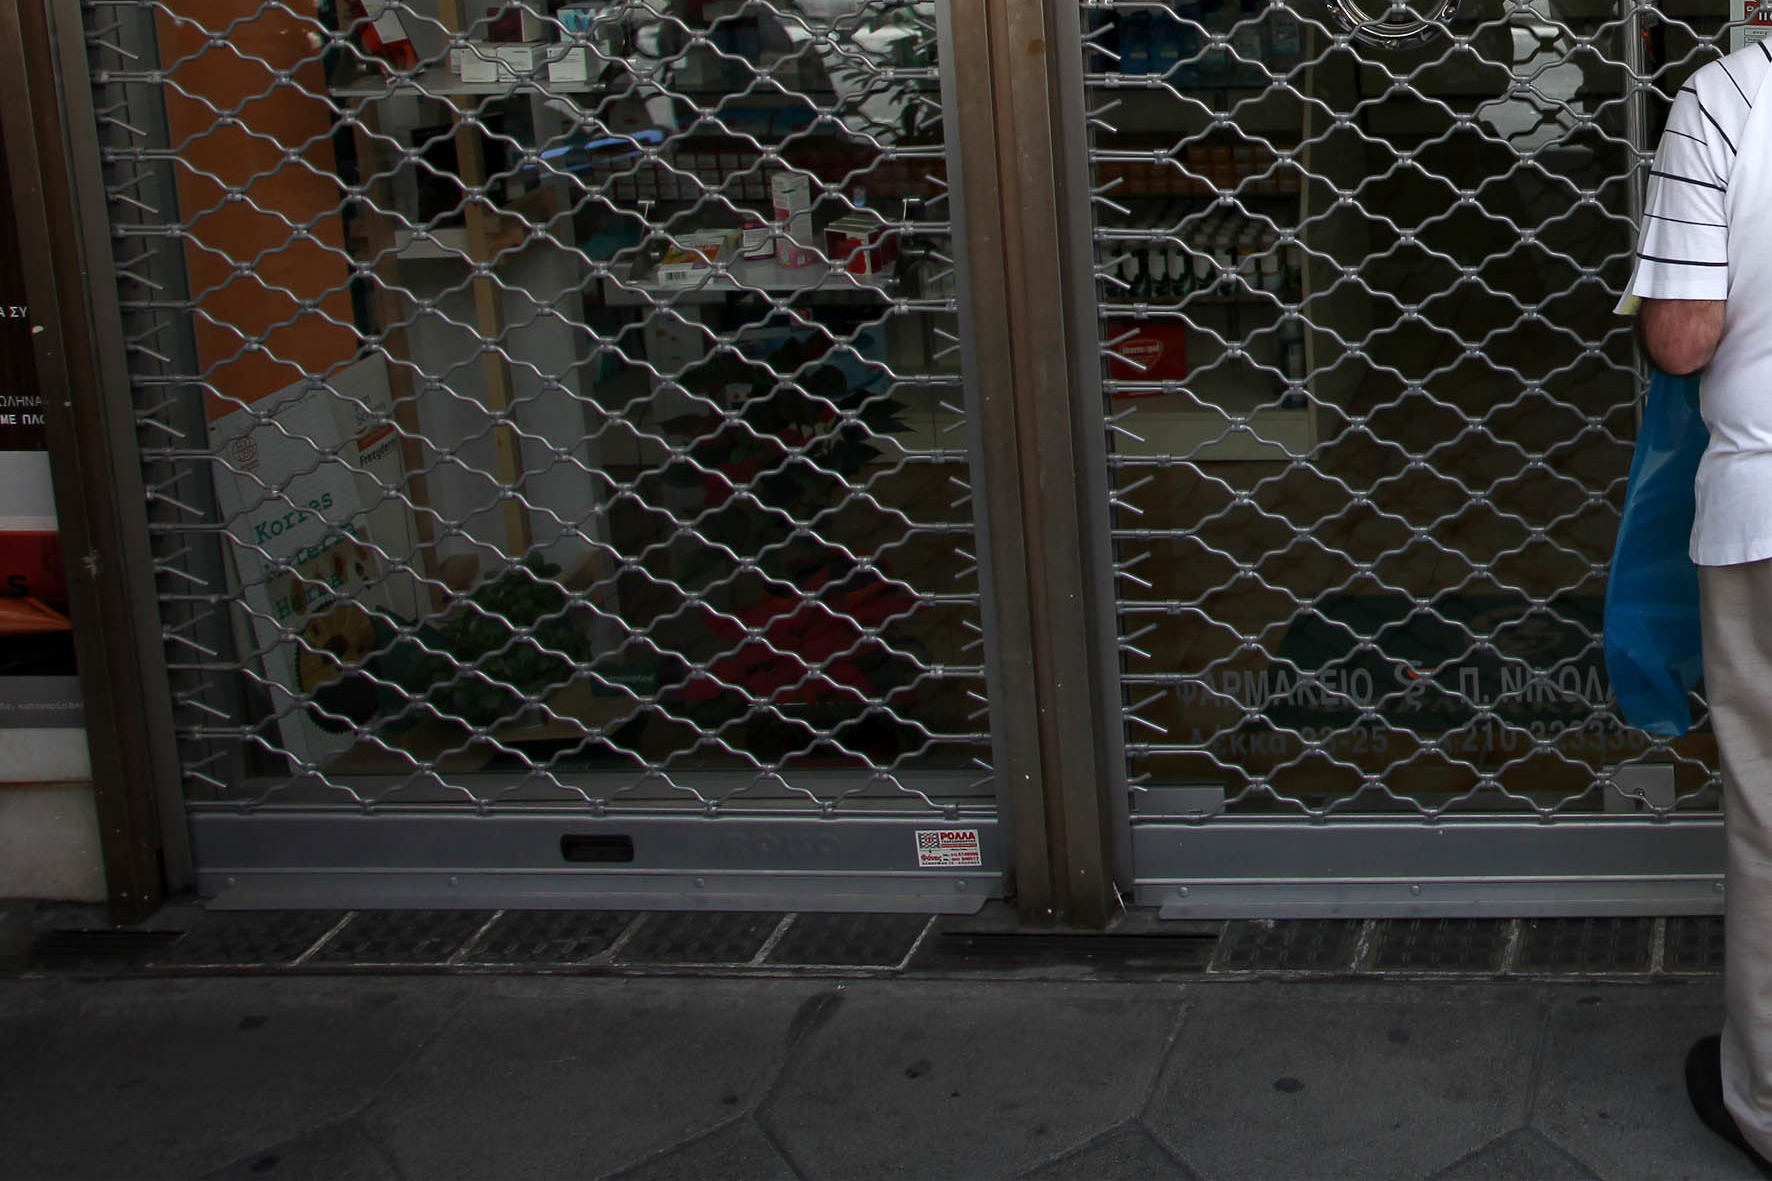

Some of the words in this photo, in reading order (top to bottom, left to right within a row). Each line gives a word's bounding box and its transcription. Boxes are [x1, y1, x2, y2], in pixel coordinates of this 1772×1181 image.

[9, 306, 27, 318] ΣΥ
[254, 492, 333, 546] Korres
[940, 832, 976, 840] ΡΟΛΛΑ
